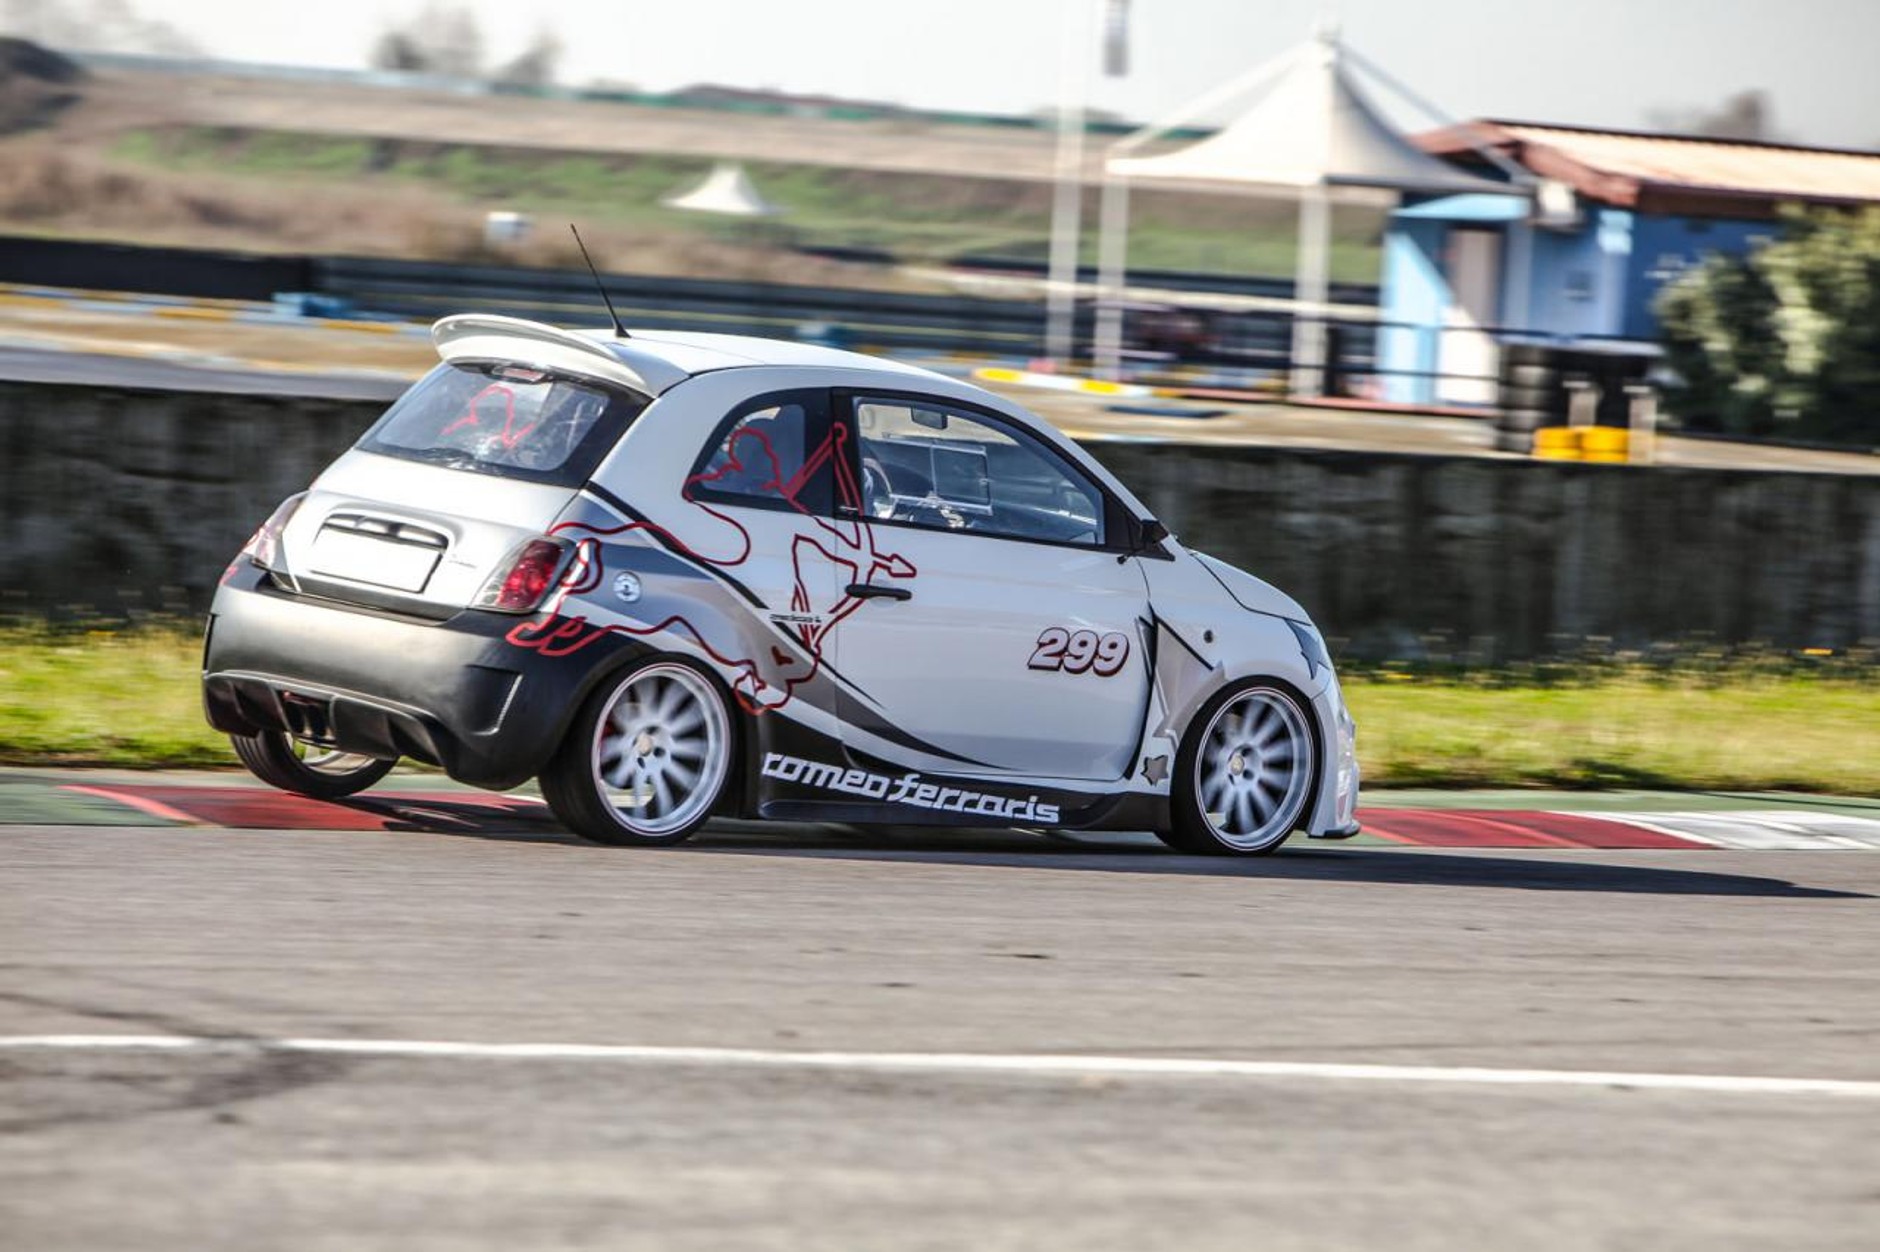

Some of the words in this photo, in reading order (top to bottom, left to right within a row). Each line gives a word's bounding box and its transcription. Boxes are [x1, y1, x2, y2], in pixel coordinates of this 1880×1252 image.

[1027, 627, 1130, 677] 299
[762, 752, 890, 799] romeo
[886, 773, 1060, 823] ferraris
